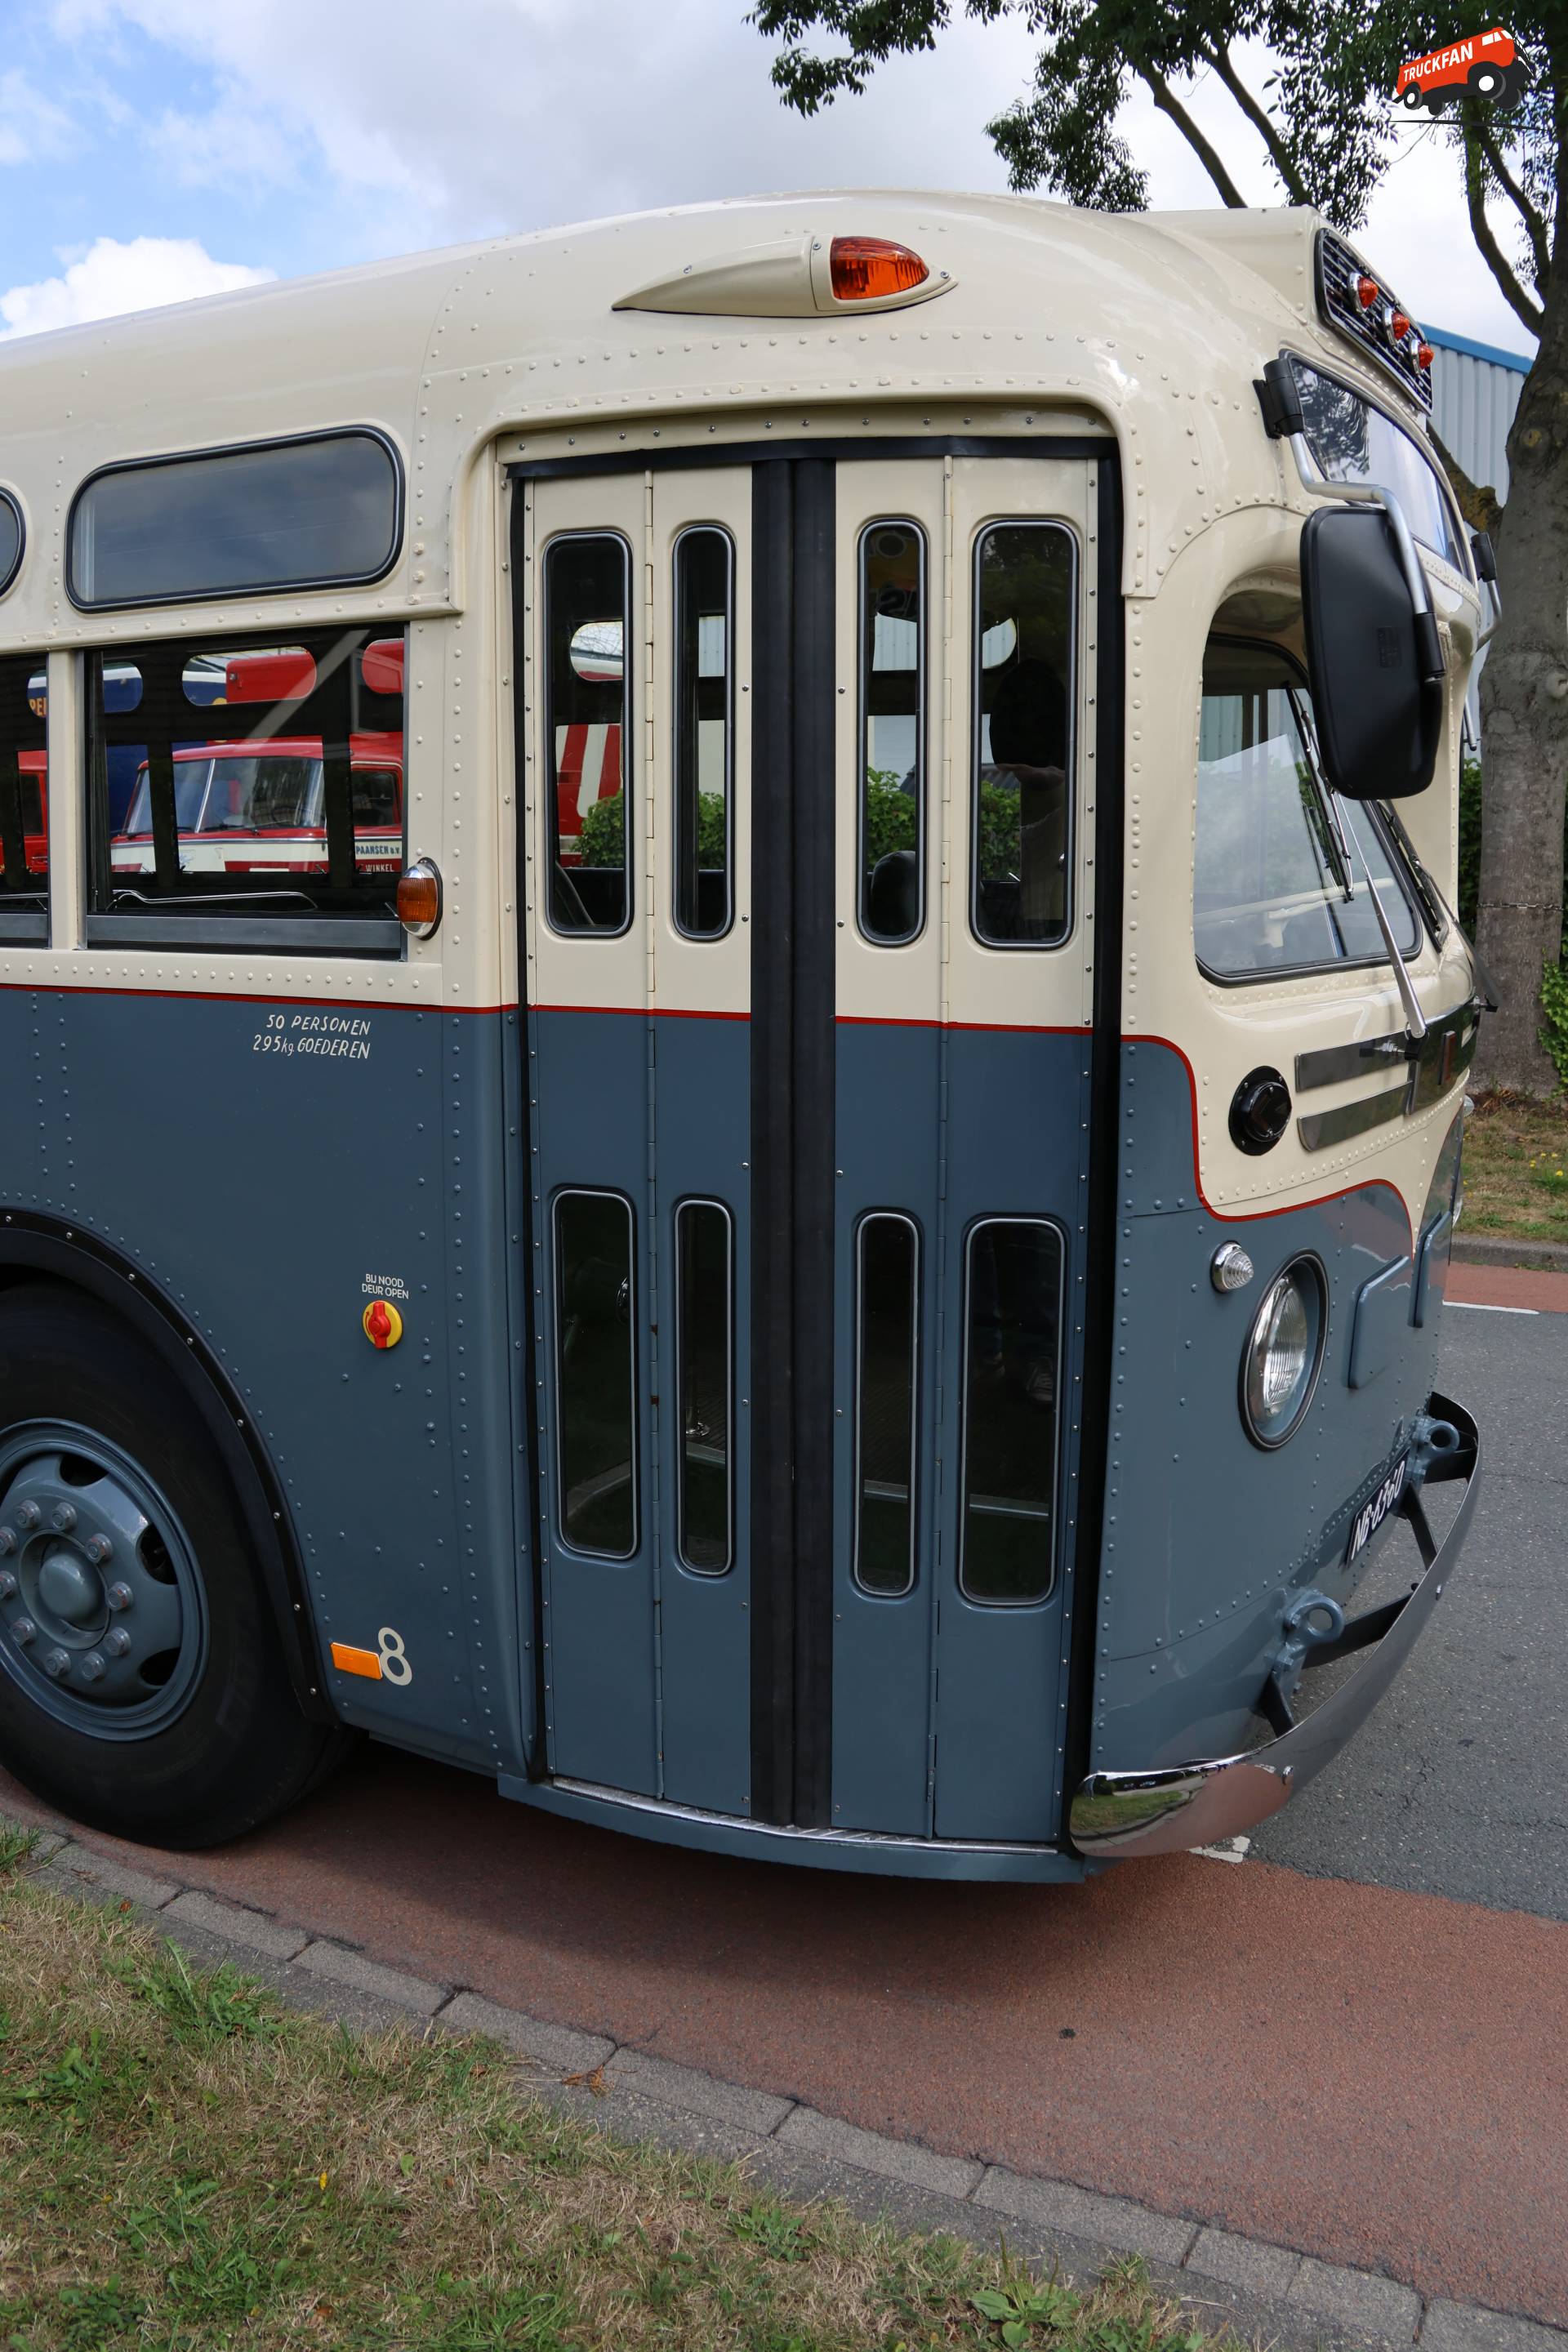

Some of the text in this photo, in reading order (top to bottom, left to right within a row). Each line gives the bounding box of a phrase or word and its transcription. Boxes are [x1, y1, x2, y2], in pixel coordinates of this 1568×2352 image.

[365, 863, 394, 873] WINKEL
[266, 1014, 371, 1036] 50 PERSONEN
[296, 1037, 371, 1059] GOEDEREN
[365, 1273, 404, 1288] BIJ NOOD
[361, 1283, 409, 1299] DEUR OPEN
[377, 1627, 412, 1686] 8
